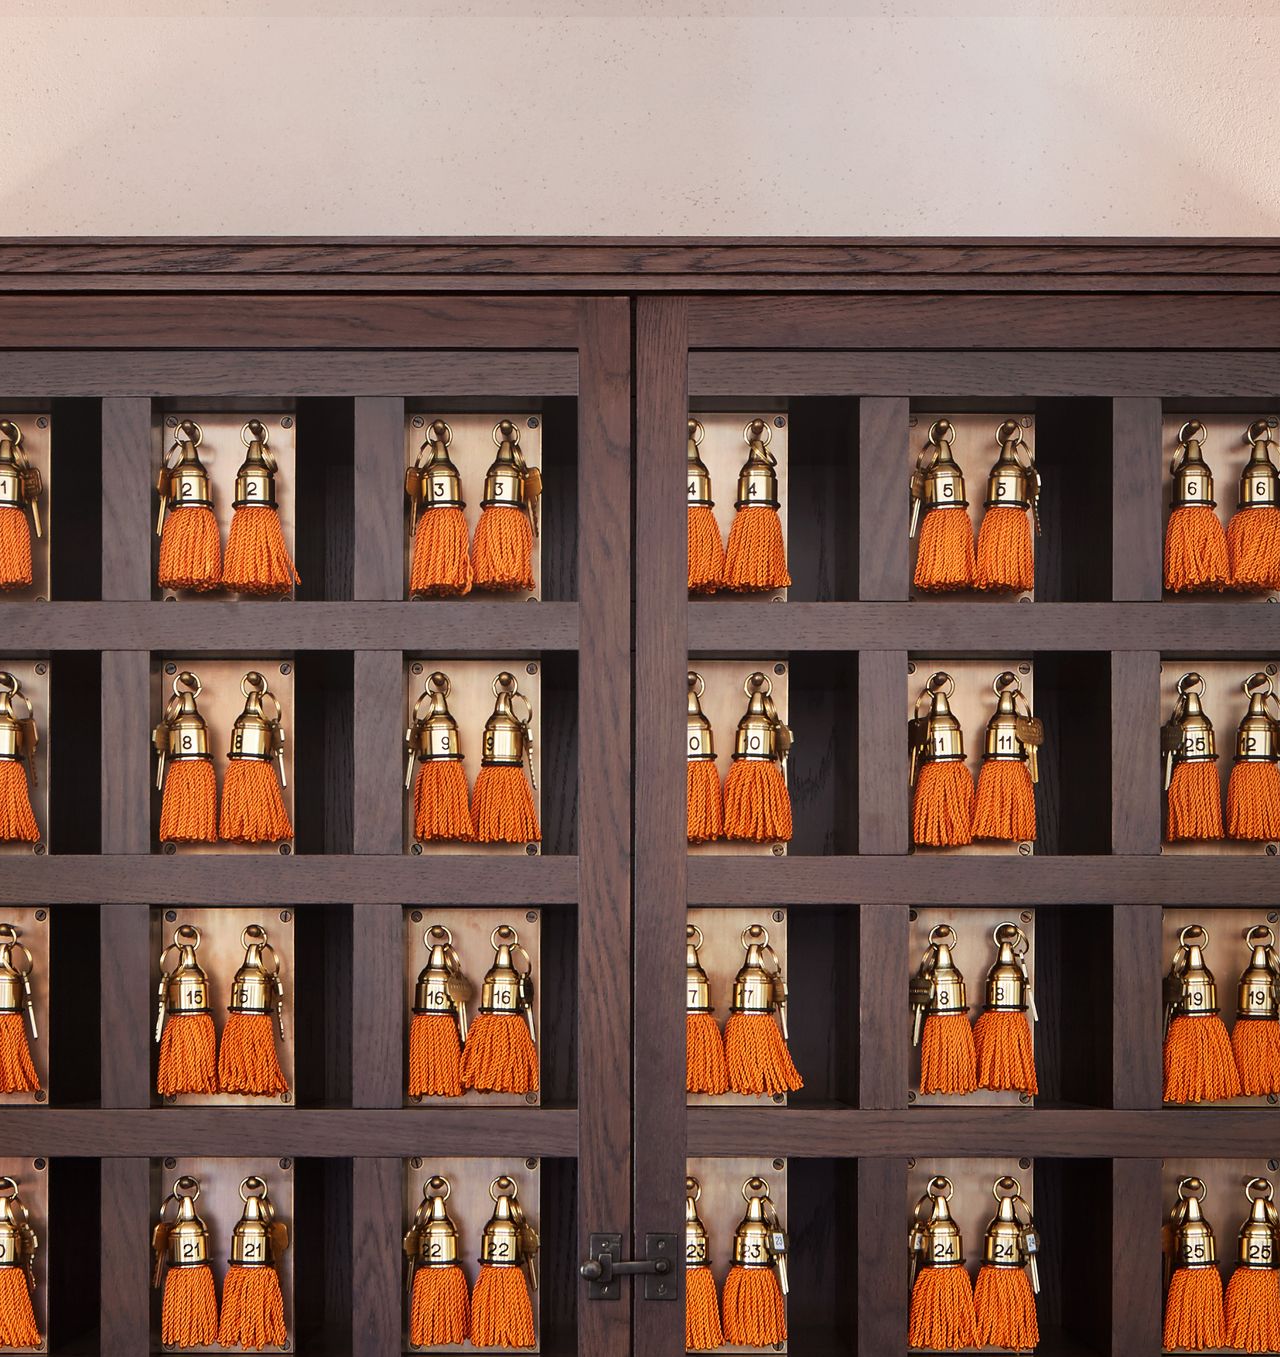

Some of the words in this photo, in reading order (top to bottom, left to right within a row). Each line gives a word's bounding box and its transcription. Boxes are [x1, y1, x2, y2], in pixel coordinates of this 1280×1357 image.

[0, 480, 7, 494] 1
[182, 483, 192, 496] 2
[247, 482, 257, 496] 2
[434, 483, 444, 497] 3
[494, 482, 503, 496] 3
[688, 482, 696, 495] 4
[748, 482, 757, 496] 4
[943, 484, 953, 497] 5
[997, 482, 1006, 496] 5
[1188, 482, 1197, 496] 6
[1256, 482, 1266, 496] 6
[182, 735, 192, 749] 8
[235, 735, 243, 749] 8
[441, 737, 450, 750] 9
[486, 736, 494, 751] 9
[689, 736, 700, 750] 0
[744, 735, 761, 750] 10
[998, 735, 1012, 750] 11
[1185, 738, 1205, 752] 25
[1240, 737, 1257, 751] 12
[186, 990, 203, 1004] 15
[233, 989, 249, 1004] 15
[427, 991, 444, 1005] 16
[494, 990, 511, 1004] 16
[688, 990, 698, 1003] 7
[1186, 992, 1203, 1006] 19
[1248, 991, 1265, 1005] 19
[183, 1243, 200, 1257] 21
[245, 1243, 261, 1258] 21
[422, 1243, 441, 1258] 22
[488, 1242, 509, 1257] 22
[686, 1244, 705, 1258] 23
[742, 1244, 761, 1258] 23
[934, 1243, 954, 1258] 24
[994, 1244, 1013, 1258] 24
[1184, 1245, 1204, 1258] 25
[1249, 1245, 1271, 1260] 25
